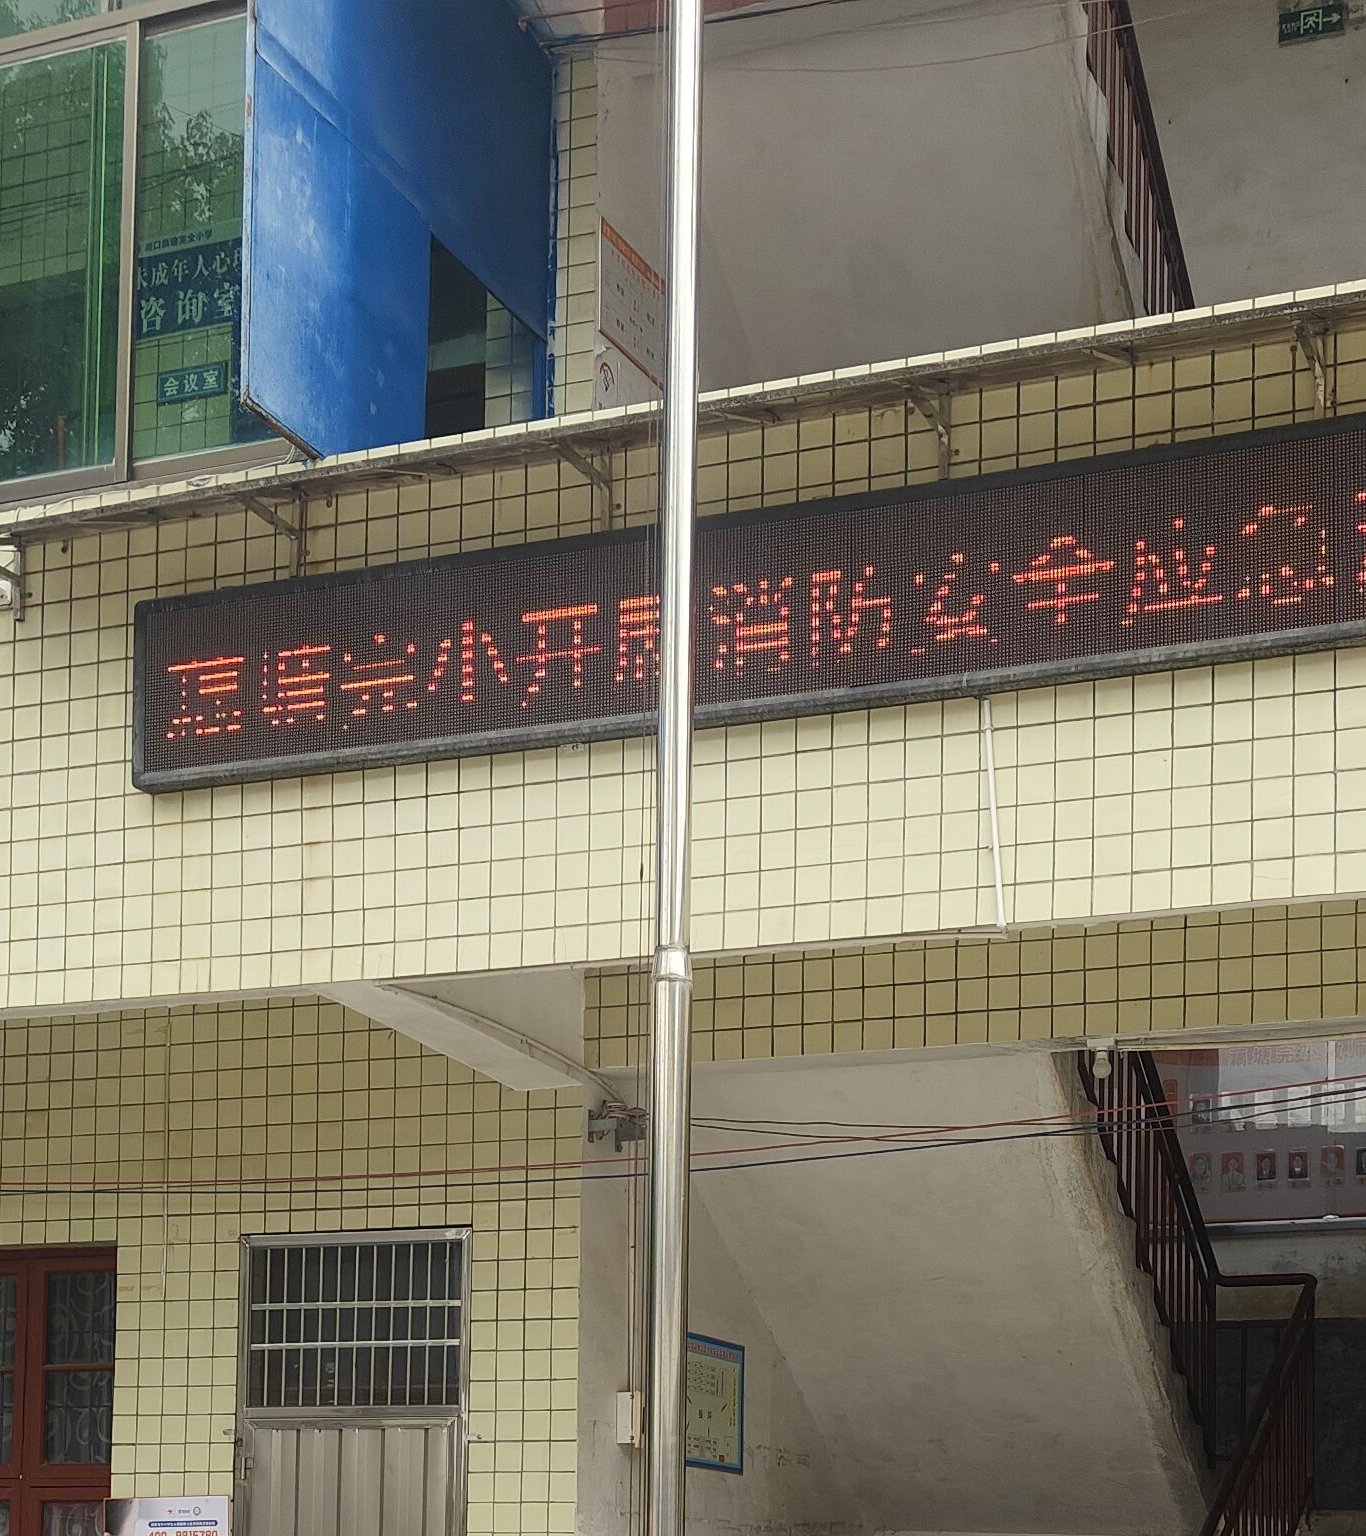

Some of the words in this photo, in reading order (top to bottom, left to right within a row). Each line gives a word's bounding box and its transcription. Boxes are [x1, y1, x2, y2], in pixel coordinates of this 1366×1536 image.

[140, 281, 238, 334] 咨询室
[164, 369, 219, 397] 会议室
